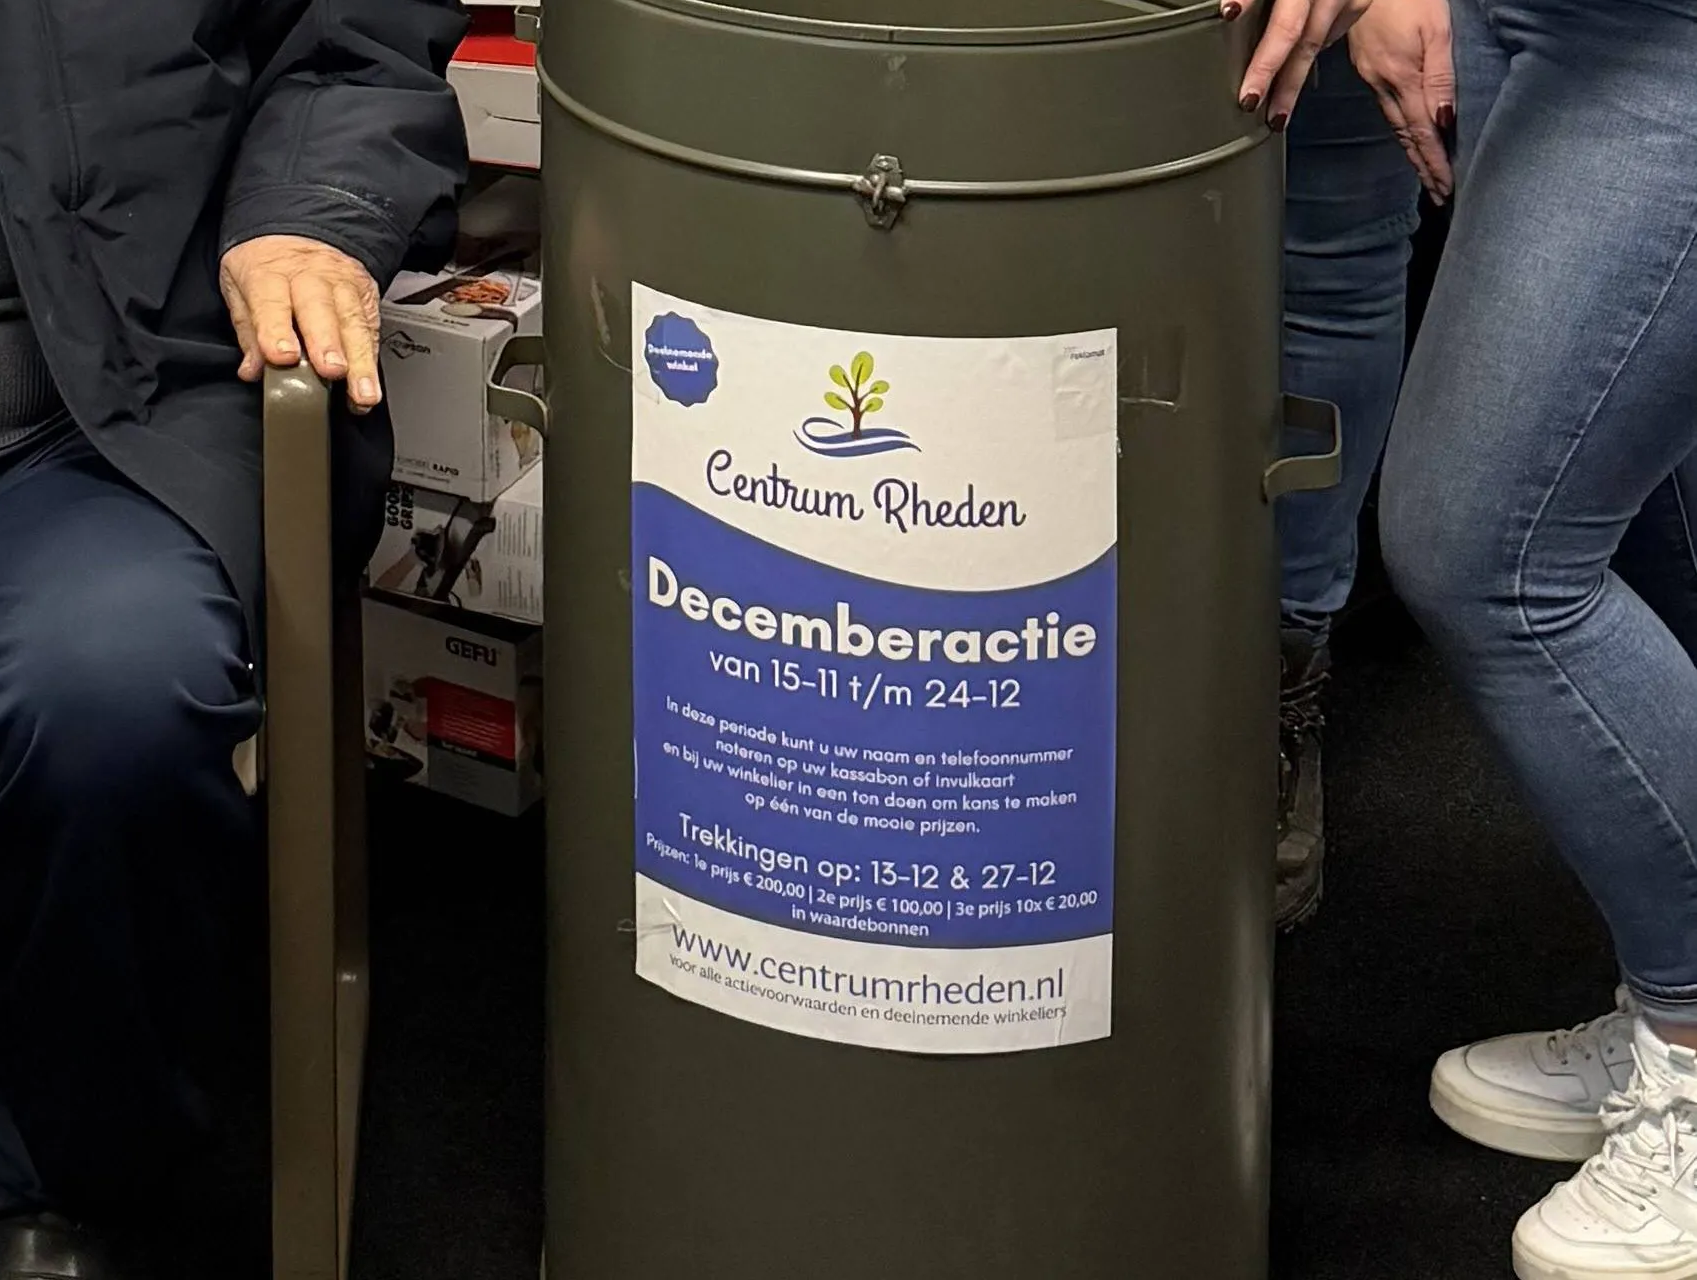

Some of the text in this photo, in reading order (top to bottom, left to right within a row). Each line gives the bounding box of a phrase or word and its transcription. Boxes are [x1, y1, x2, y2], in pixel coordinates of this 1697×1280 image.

[647, 343, 713, 360] Deelnemende
[666, 360, 699, 372] winkel
[705, 449, 1027, 534] Centrum Rheden
[648, 555, 1097, 663] Decemberactie
[445, 636, 497, 667] GEFU
[709, 651, 1021, 710] van 15-11 t/m 24-12
[666, 695, 1074, 766] In deze periode kunt u uw naam en telefoonnummer
[715, 739, 1015, 789] noteren op uw kassabon of invulkaart
[663, 741, 1077, 811] en bij uw winkelier in een ton doen om kans te maken
[745, 792, 981, 837] op één van de mooie prijzen.
[646, 832, 691, 865] Prijzen:
[694, 853, 707, 871] 1e
[710, 863, 740, 885] prijs
[743, 871, 753, 886] €
[756, 875, 806, 899] 200,00
[816, 891, 836, 905] 2e
[839, 894, 872, 912] prijs
[876, 897, 887, 912] €
[892, 898, 943, 917] 100,00
[955, 902, 974, 916] 3e
[978, 900, 1012, 919] prijs
[1016, 898, 1042, 913] 10x
[1045, 896, 1056, 910] €
[1058, 890, 1098, 910] 20,00
[679, 812, 1057, 890] Trekkingen op: 13-12 & 27-12
[791, 904, 930, 937] in waardebonnen
[669, 953, 1067, 1026] voor alle actievoorwaarden en deelnemende winkeliers
[672, 923, 1064, 1005] www.centrumrheden.nl
